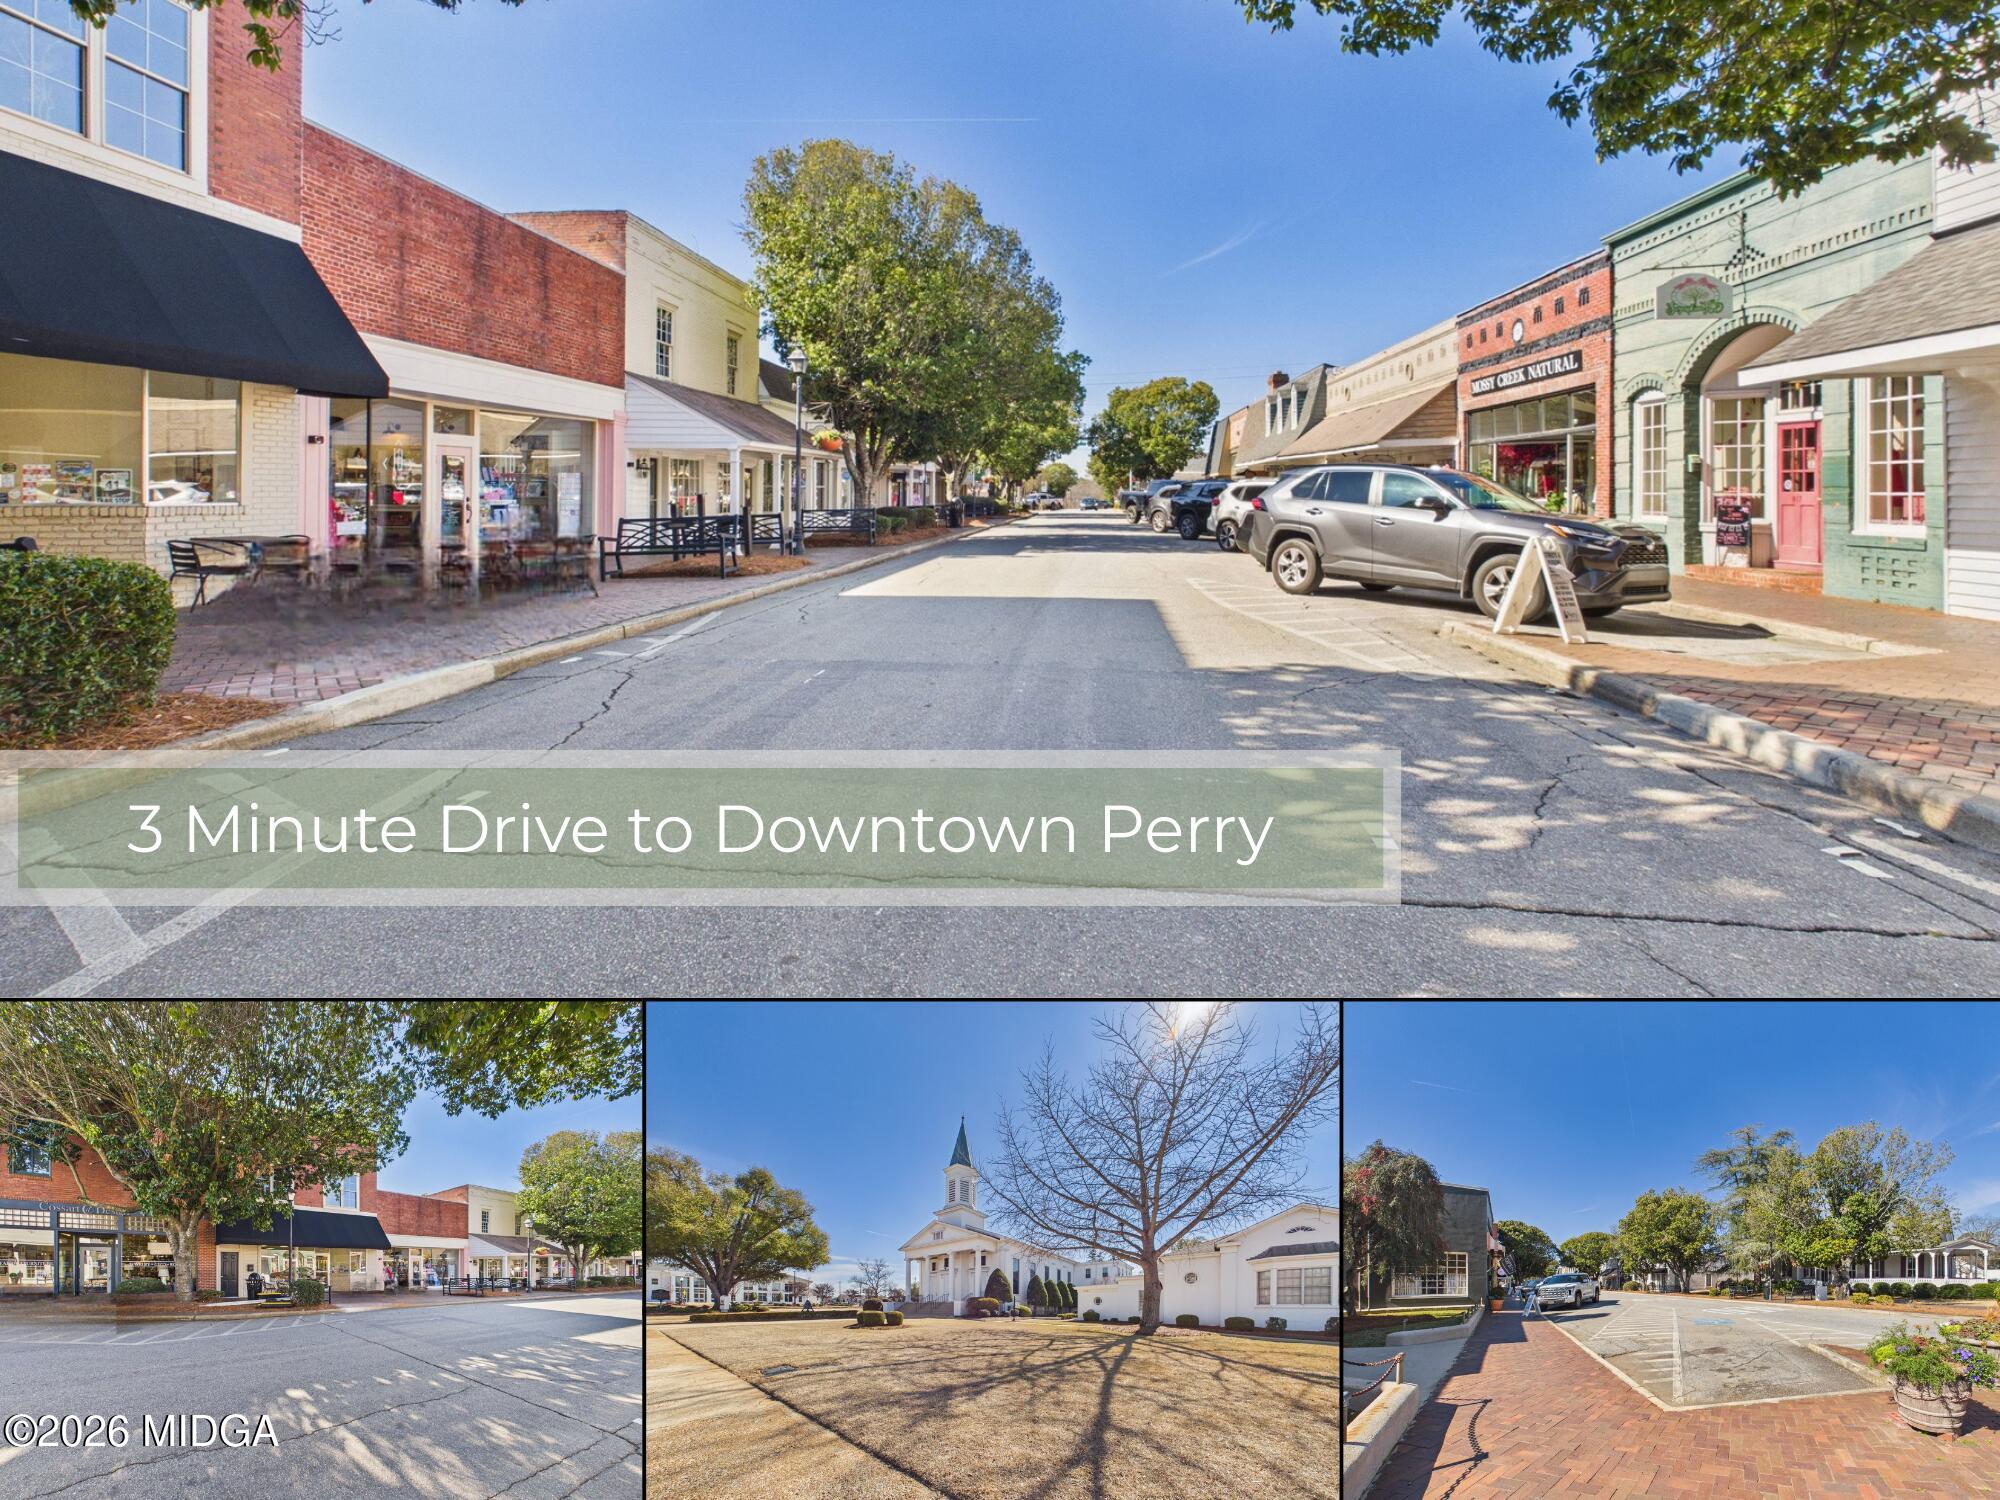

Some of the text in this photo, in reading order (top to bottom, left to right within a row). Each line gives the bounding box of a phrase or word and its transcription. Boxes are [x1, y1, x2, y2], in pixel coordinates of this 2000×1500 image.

[1471, 354, 1579, 394] MOSSY CREEK NATURAL
